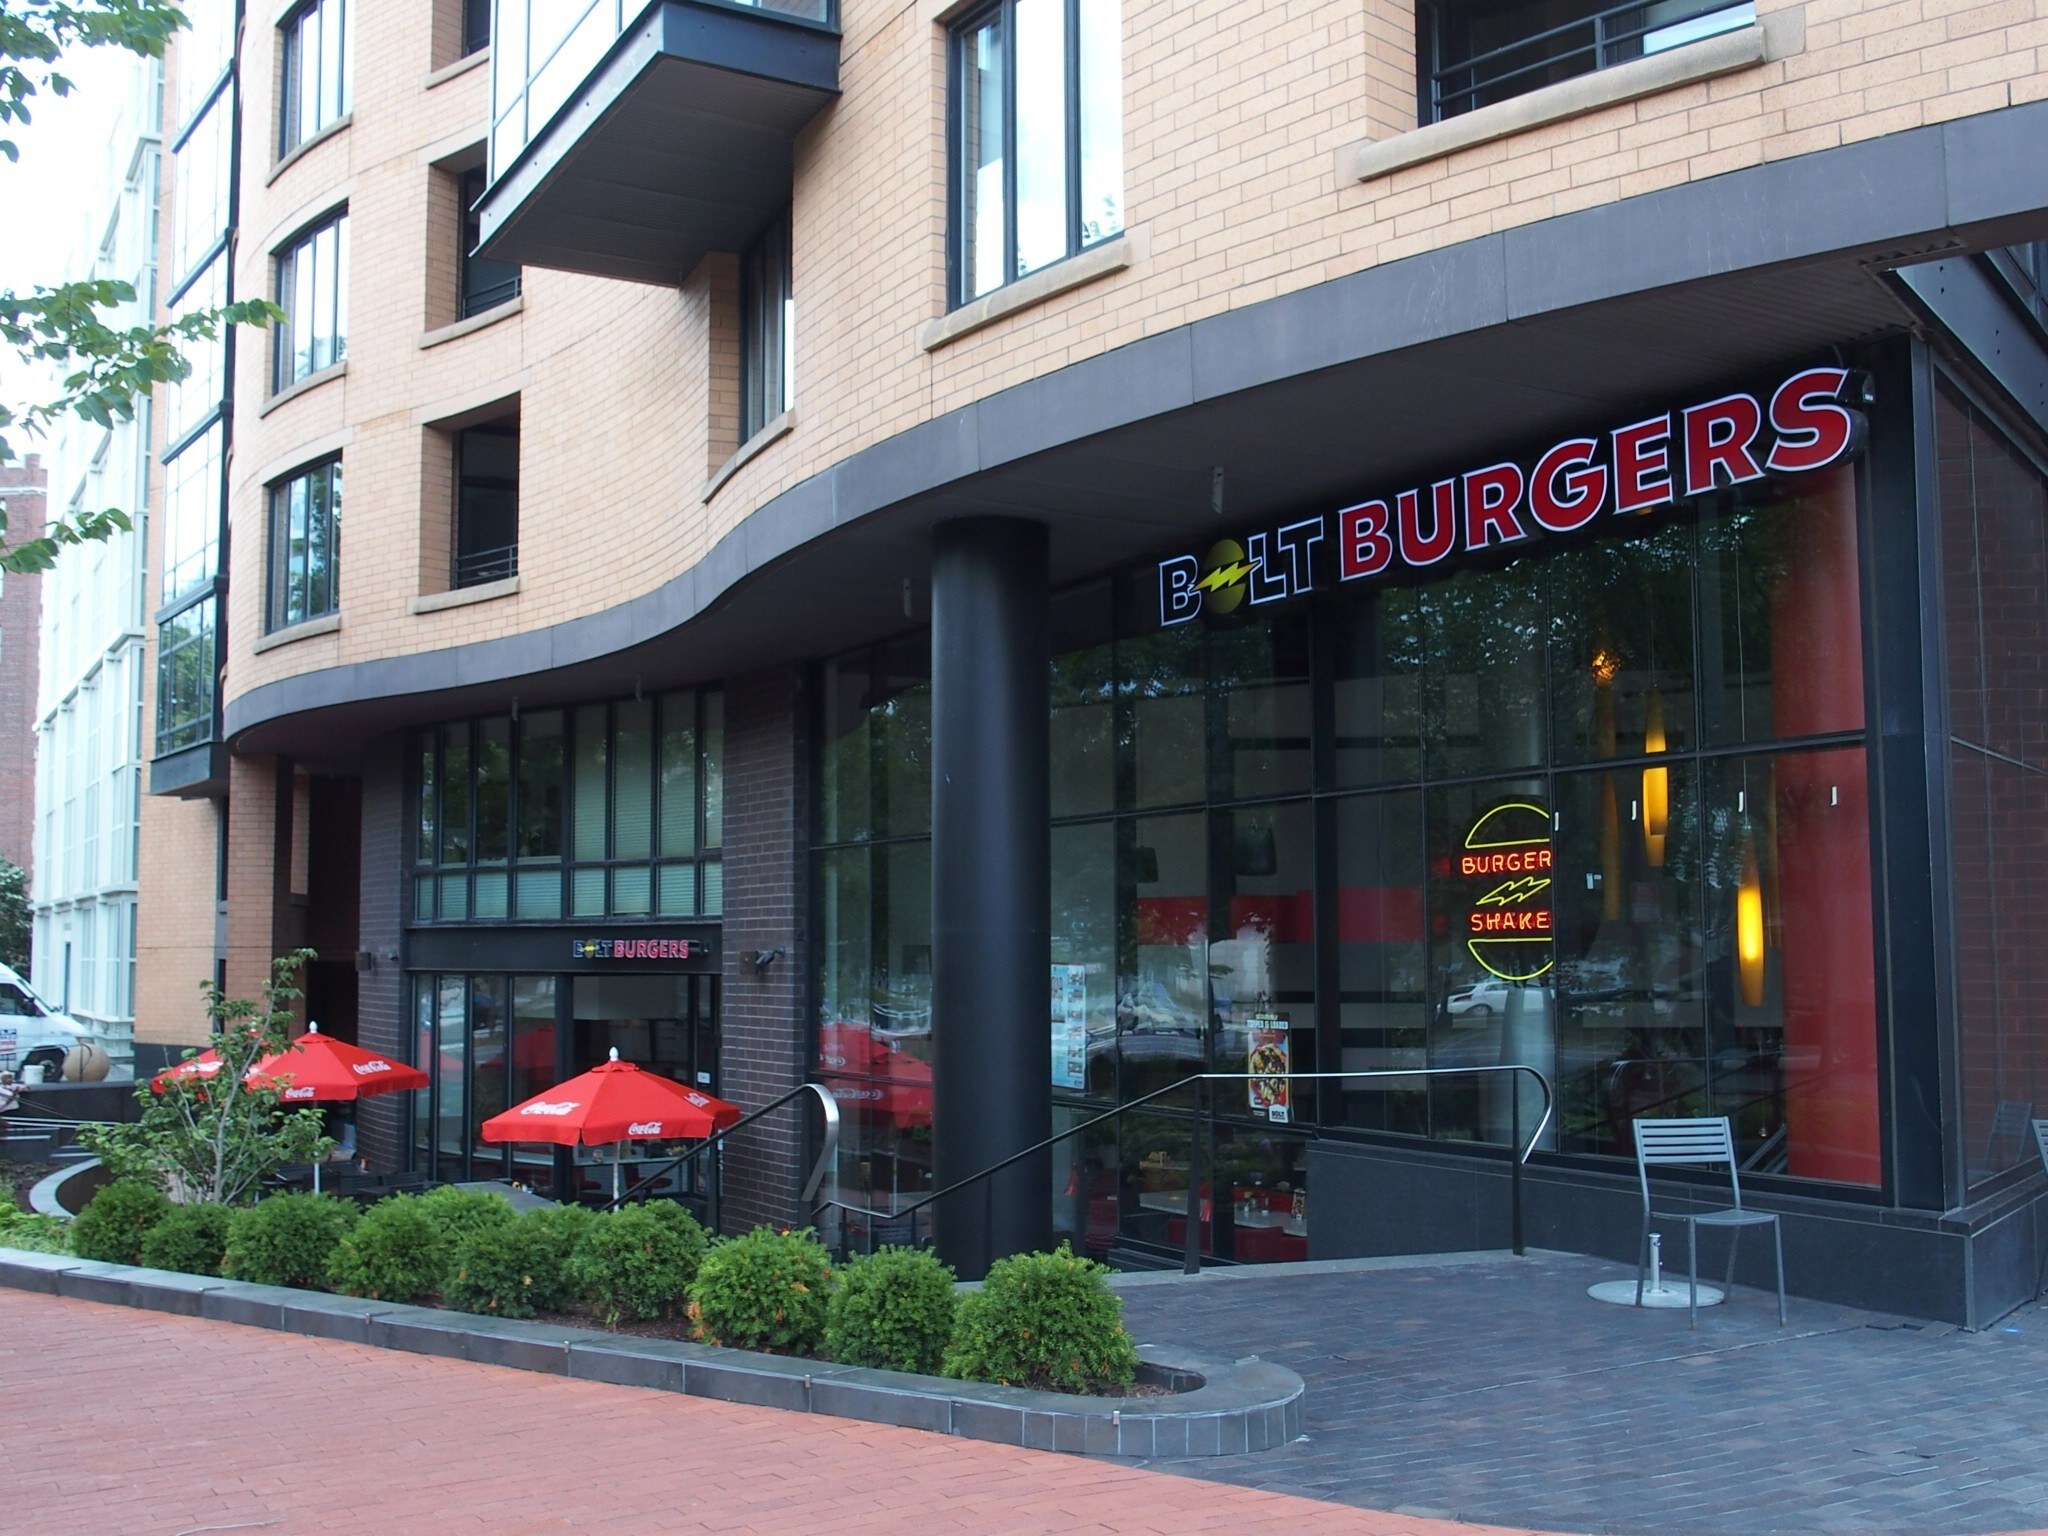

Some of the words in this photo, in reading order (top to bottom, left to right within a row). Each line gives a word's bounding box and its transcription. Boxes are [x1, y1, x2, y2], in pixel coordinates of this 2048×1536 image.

[1158, 514, 1324, 626] BOLT
[1338, 367, 1852, 582] BURGERS
[1462, 851, 1552, 874] BURGER
[1471, 912, 1550, 931] SHAKE
[614, 939, 689, 959] BURGERS
